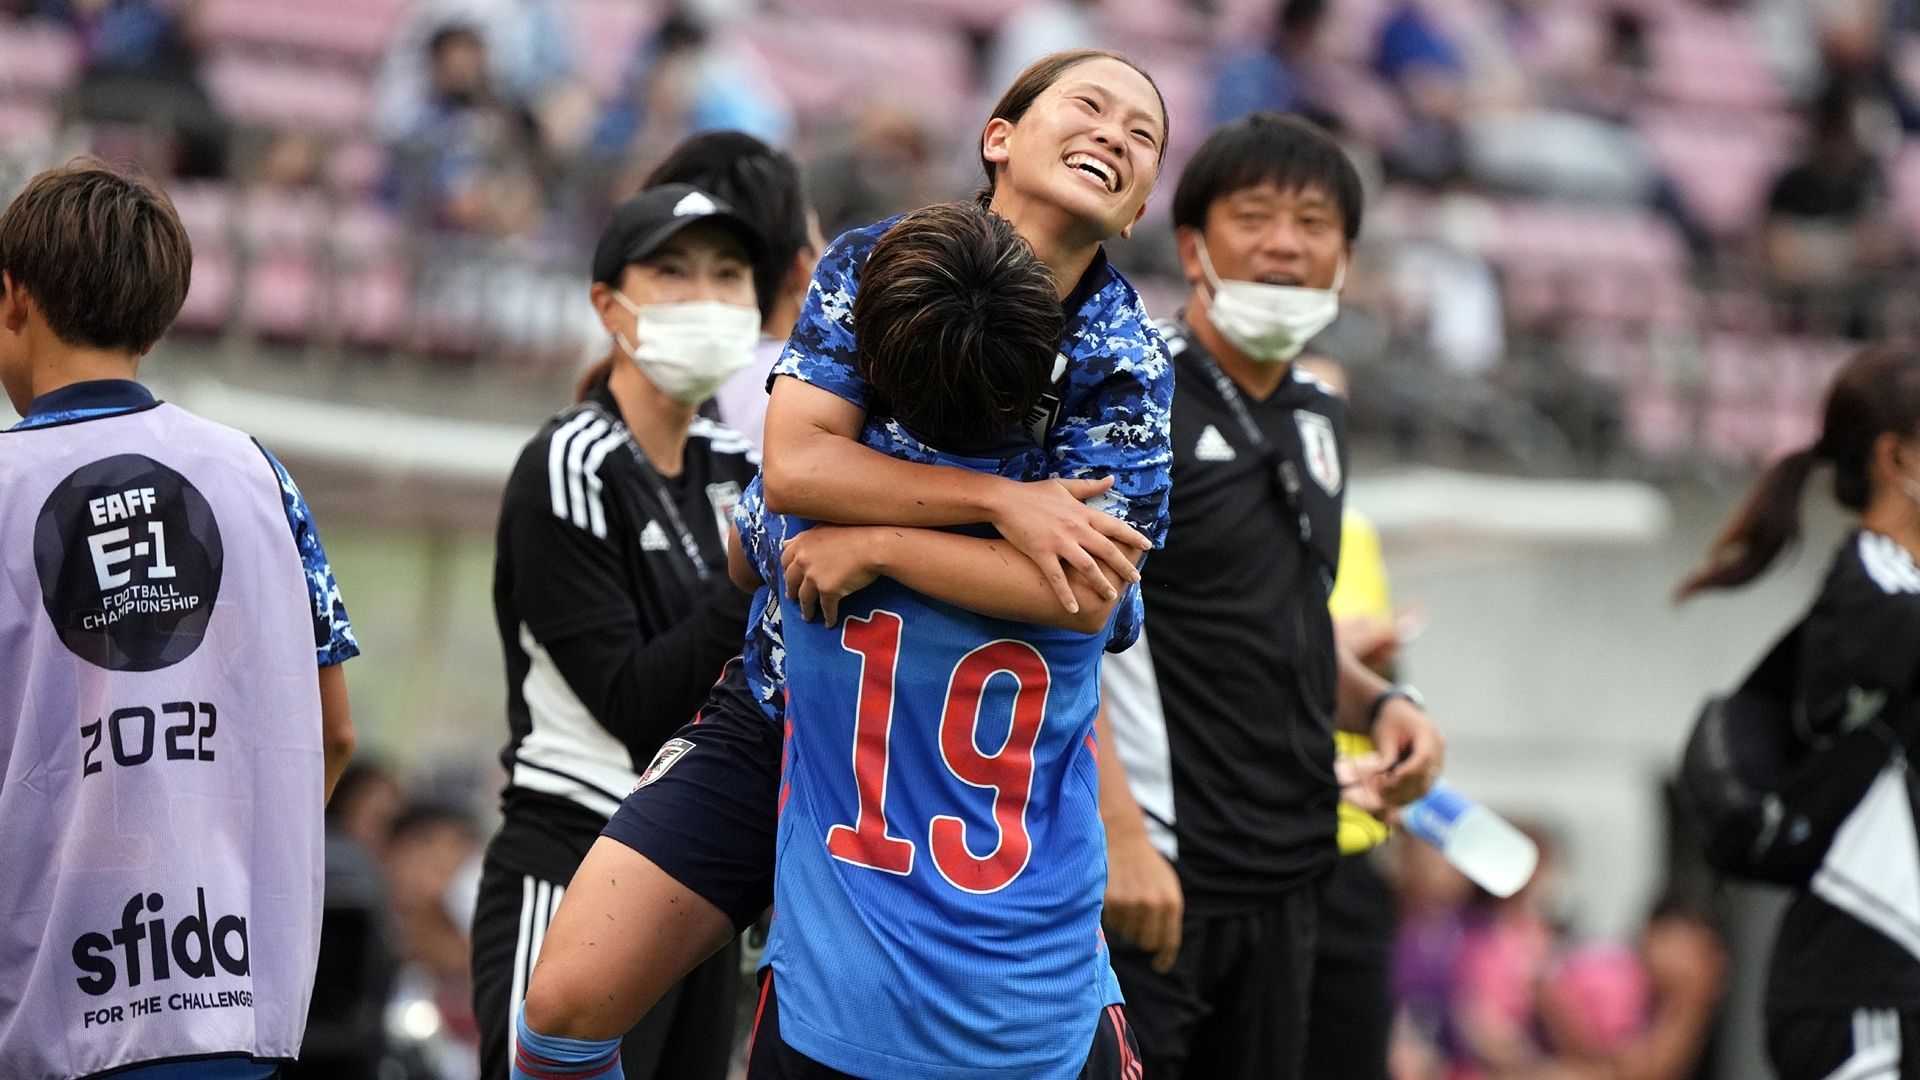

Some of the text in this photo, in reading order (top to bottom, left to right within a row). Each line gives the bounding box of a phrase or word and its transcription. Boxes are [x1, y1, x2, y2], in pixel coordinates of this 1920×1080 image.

[89, 487, 156, 527] EAFF
[87, 521, 176, 591] E-1
[83, 595, 199, 630] CHAMPIONSHIP
[103, 585, 180, 610] FOOTBALL
[80, 701, 217, 779] 2022
[825, 608, 1051, 895] 19
[72, 887, 251, 996] sfida
[84, 1006, 124, 1028] FOR
[130, 996, 162, 1018] THE
